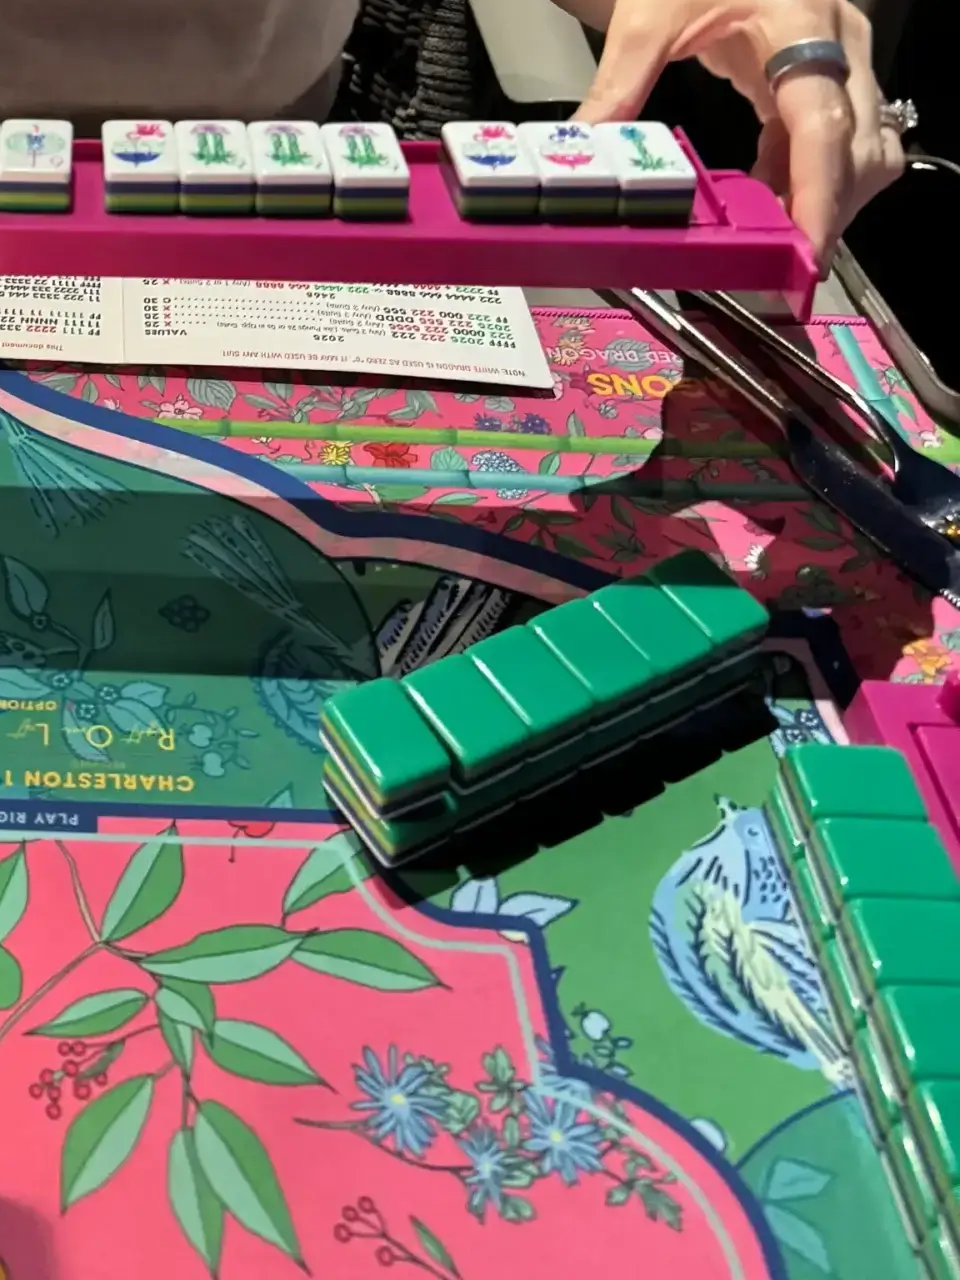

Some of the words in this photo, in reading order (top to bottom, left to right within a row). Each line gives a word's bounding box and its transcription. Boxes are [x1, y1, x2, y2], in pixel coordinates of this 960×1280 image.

[33, 278, 48, 286] 22
[52, 279, 75, 287] 1111
[8, 290, 30, 298] 444
[53, 286, 79, 294] 2222
[347, 286, 370, 294] 222
[33, 292, 60, 300] 3333
[479, 296, 501, 304] 222
[144, 304, 158, 312] 30
[50, 310, 84, 318] 11111
[410, 309, 434, 317] 222
[20, 316, 58, 326] NNNN
[376, 314, 414, 323] DDDD
[467, 313, 491, 322] 222
[64, 319, 99, 328] 11111
[448, 320, 472, 328] 222
[26, 325, 56, 334] 2222
[63, 326, 84, 335] 111
[424, 326, 448, 334] 222
[391, 331, 416, 340] 222
[420, 334, 446, 342] 222
[489, 332, 514, 340] 222
[2, 342, 44, 350] document
[284, 352, 305, 360] USED
[4, 770, 13, 786] 1
[25, 770, 194, 792] CHARLESTON
[34, 812, 78, 826] PLAY
